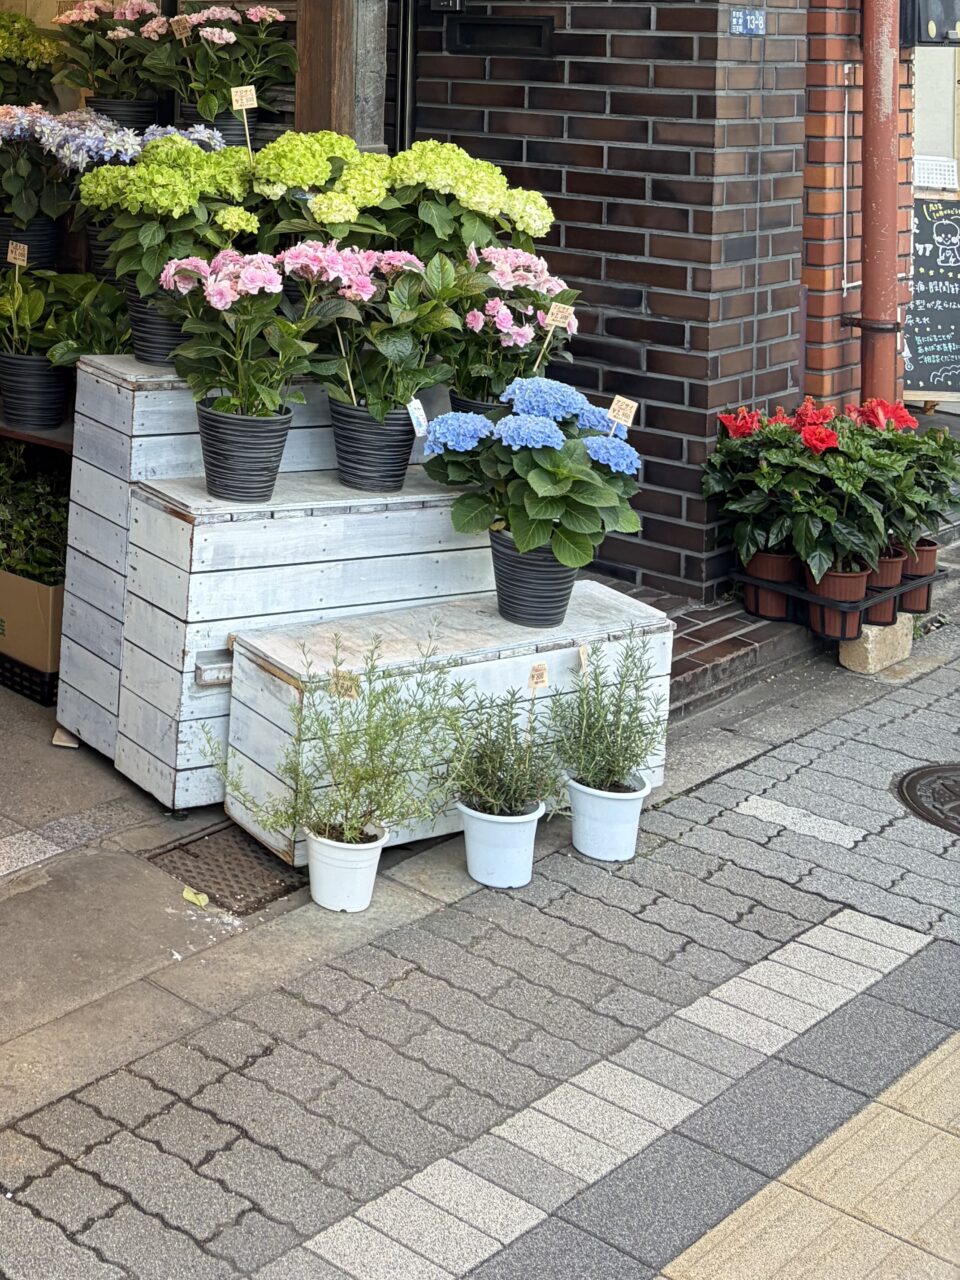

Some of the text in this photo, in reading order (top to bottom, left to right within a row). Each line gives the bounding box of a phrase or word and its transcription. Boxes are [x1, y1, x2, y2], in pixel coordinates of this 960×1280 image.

[746, 15, 764, 29] 13-8
[904, 314, 930, 326] 尿もれ
[915, 332, 955, 345] 気になることが
